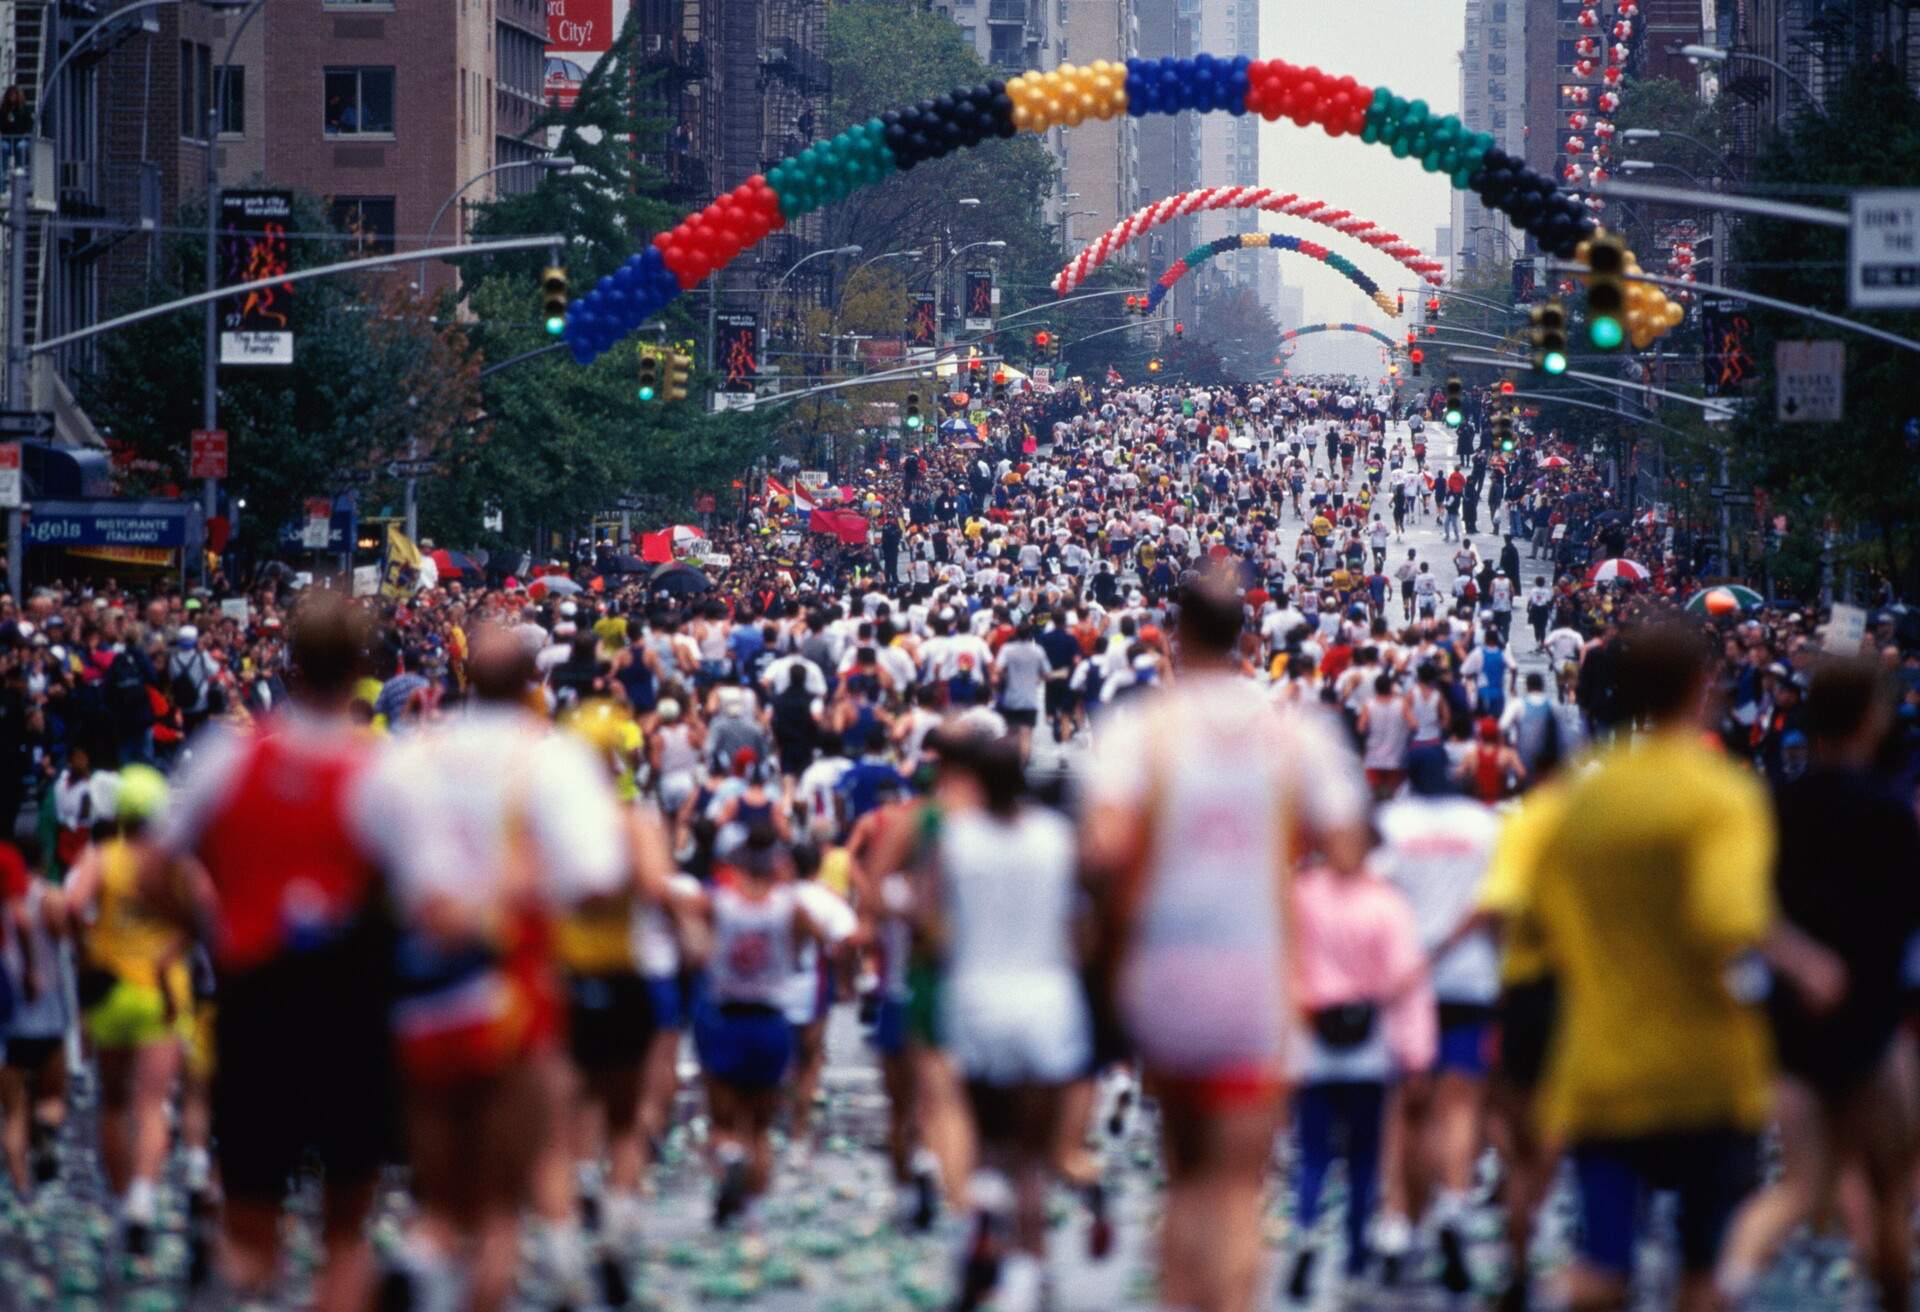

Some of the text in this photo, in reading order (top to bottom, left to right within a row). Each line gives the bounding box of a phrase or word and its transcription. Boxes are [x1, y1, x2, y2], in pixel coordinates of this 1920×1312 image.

[559, 20, 592, 46] City?
[224, 195, 285, 208] new york city
[245, 207, 289, 216] marathon
[96, 519, 169, 531] RISTORANTE
[106, 531, 158, 542] ITALIANO
